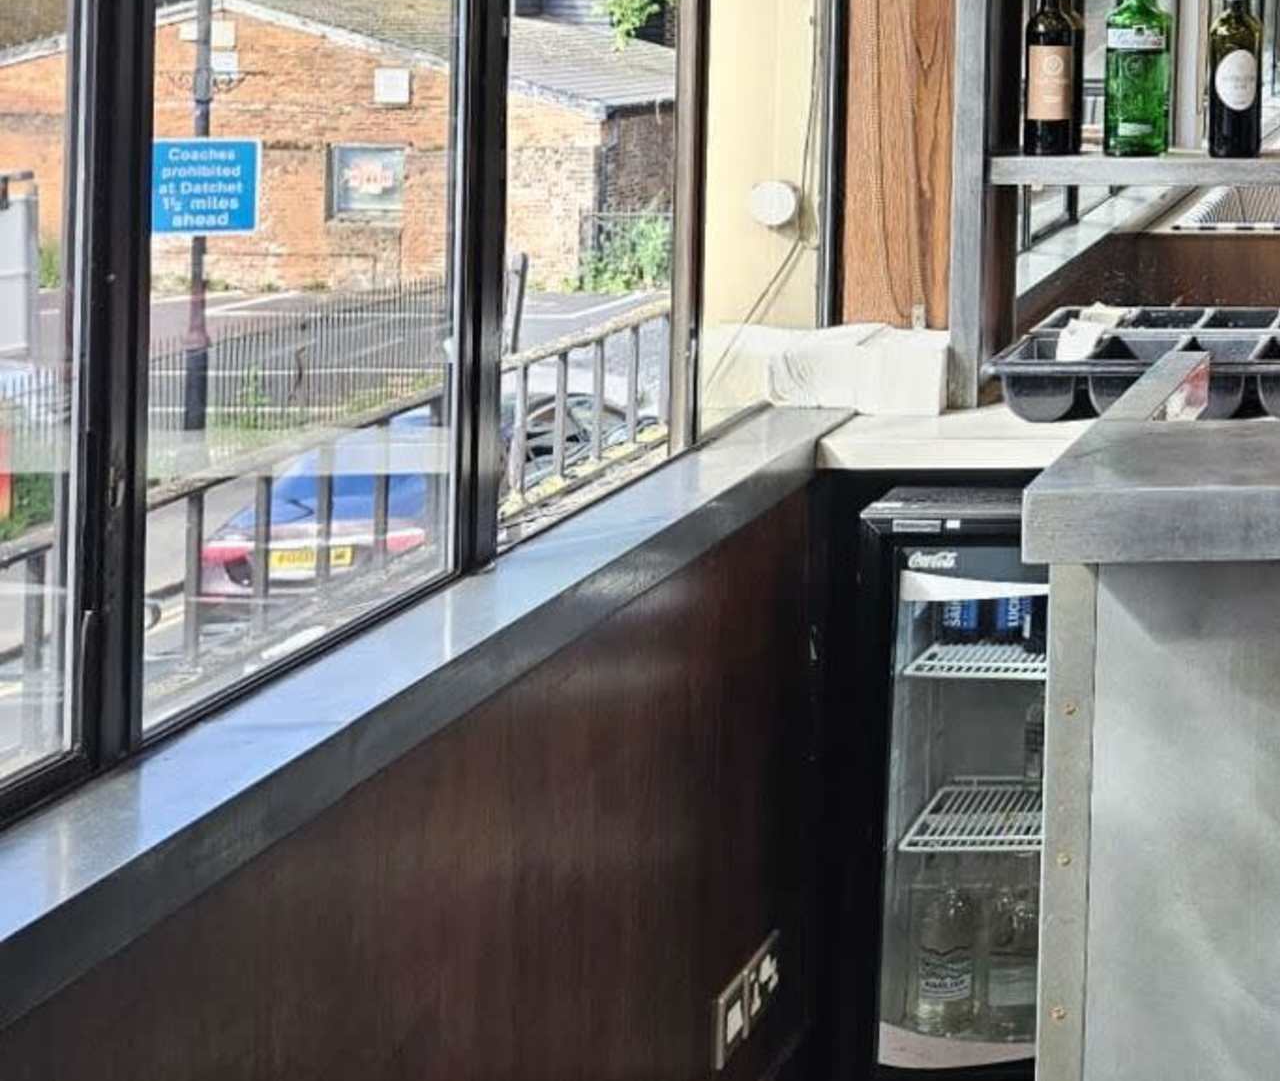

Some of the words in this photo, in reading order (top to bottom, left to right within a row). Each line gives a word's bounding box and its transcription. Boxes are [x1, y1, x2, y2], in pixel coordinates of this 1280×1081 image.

[168, 147, 236, 161] Coaches
[161, 164, 241, 180] prohibited
[159, 182, 176, 195] at
[180, 181, 243, 195] Datchet
[190, 196, 240, 211] miles
[171, 212, 230, 227] ahead
